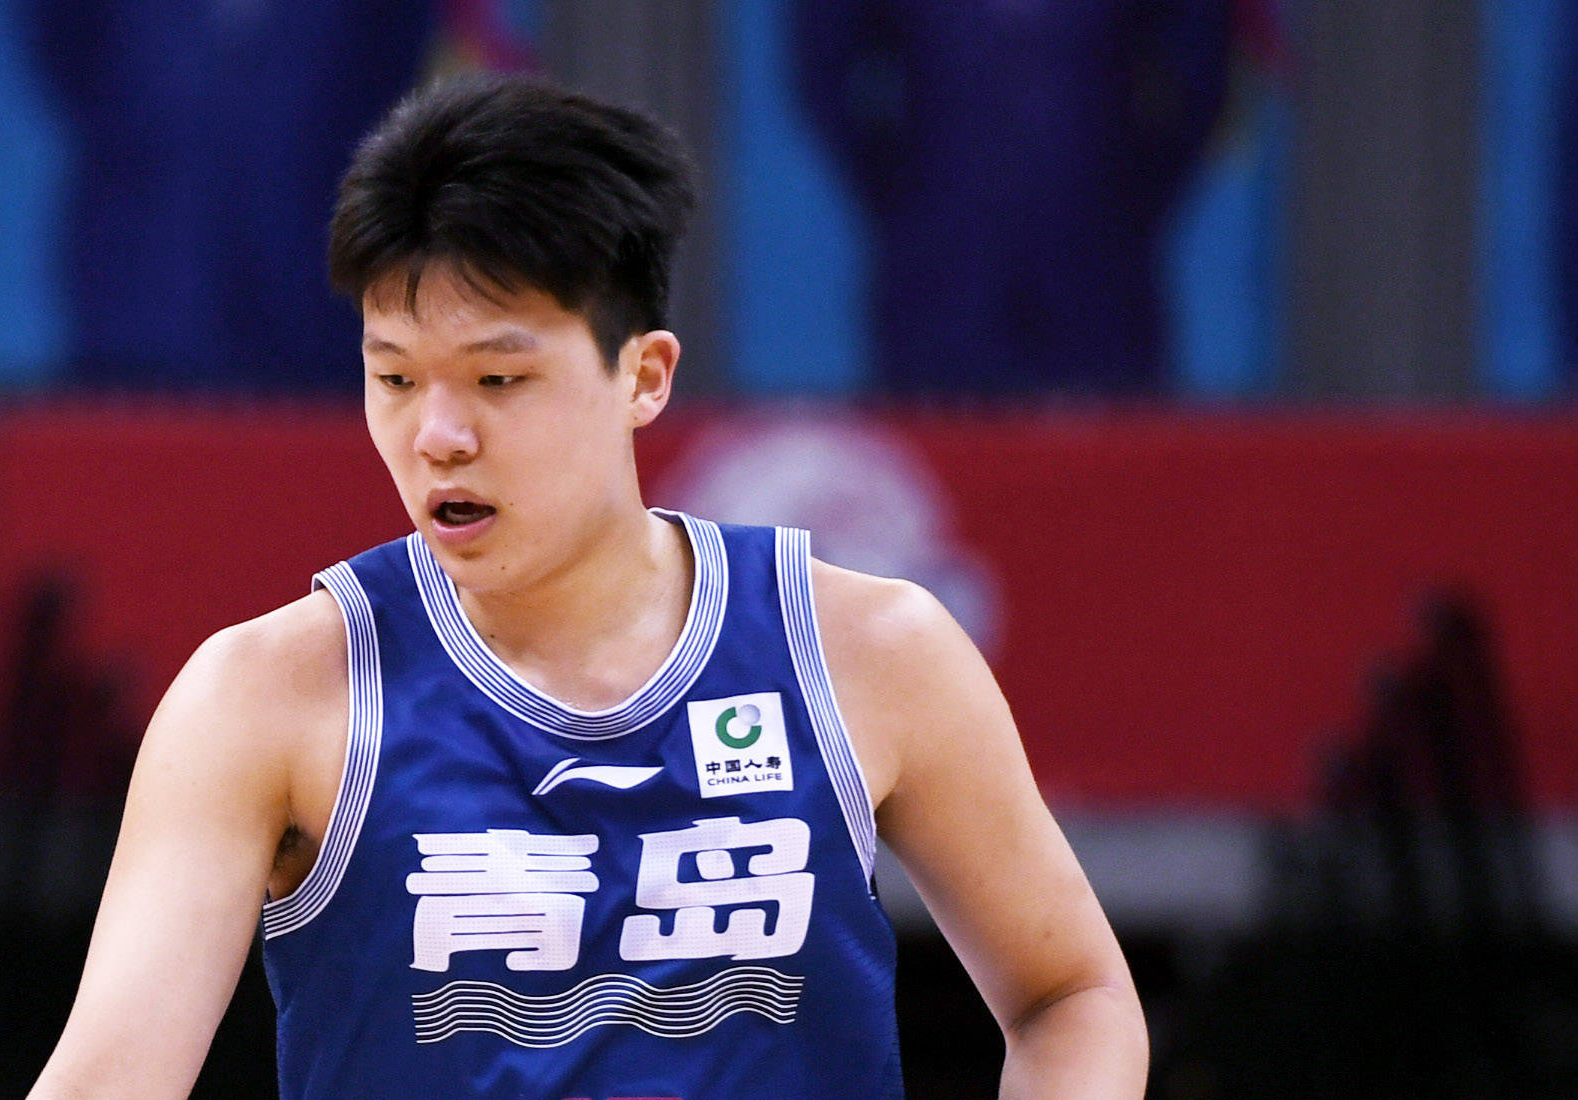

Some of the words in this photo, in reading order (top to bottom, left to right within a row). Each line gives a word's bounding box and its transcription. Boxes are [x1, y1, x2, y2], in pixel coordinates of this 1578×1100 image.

[705, 756, 782, 775] 中国人寿
[707, 775, 751, 786] CHINA
[754, 772, 783, 782] LIFE
[405, 816, 815, 972] 青岛
